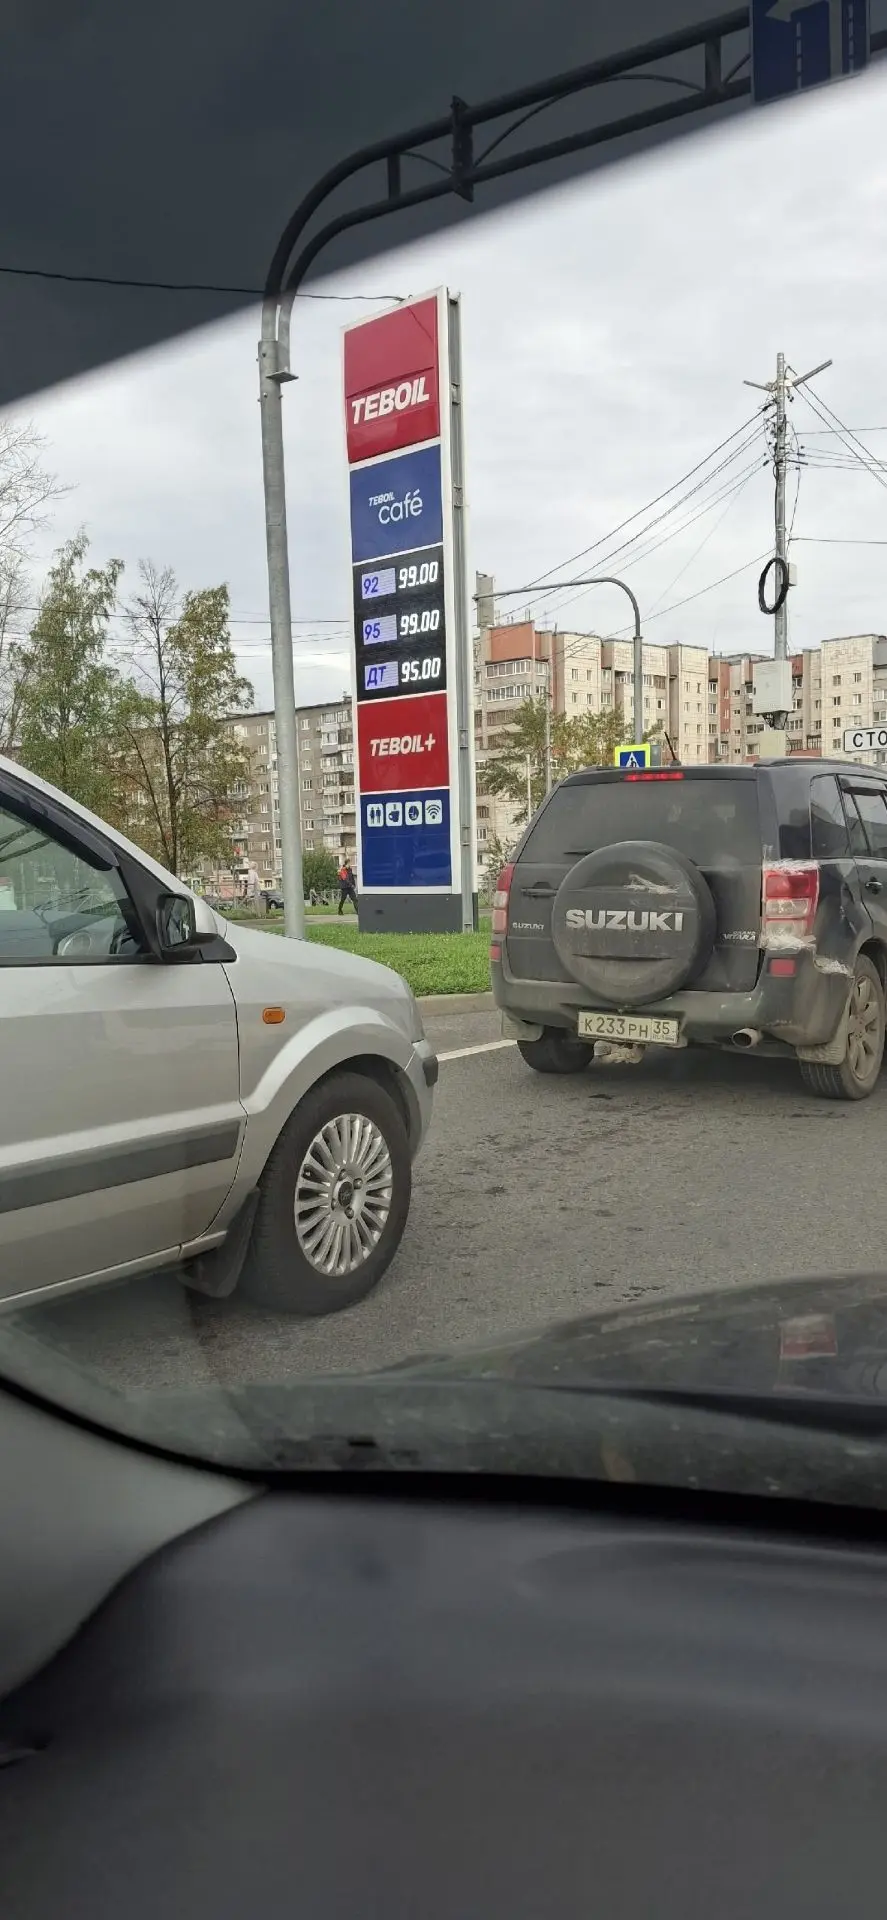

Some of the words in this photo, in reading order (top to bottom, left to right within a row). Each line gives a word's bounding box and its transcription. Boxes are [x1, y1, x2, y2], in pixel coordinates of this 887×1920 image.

[352, 377, 430, 424] TEBOIL
[368, 492, 395, 506] TEBOIL
[378, 489, 423, 524] café
[363, 577, 379, 594] 92
[398, 561, 439, 588] 99.00
[364, 622, 380, 639] 95
[400, 609, 440, 635] 99.00
[367, 665, 387, 687] ДТ
[401, 657, 442, 682] 95.00
[512, 922, 545, 930] SUZUKI
[565, 909, 683, 931] SUZUKI
[653, 1021, 670, 1035] 35
